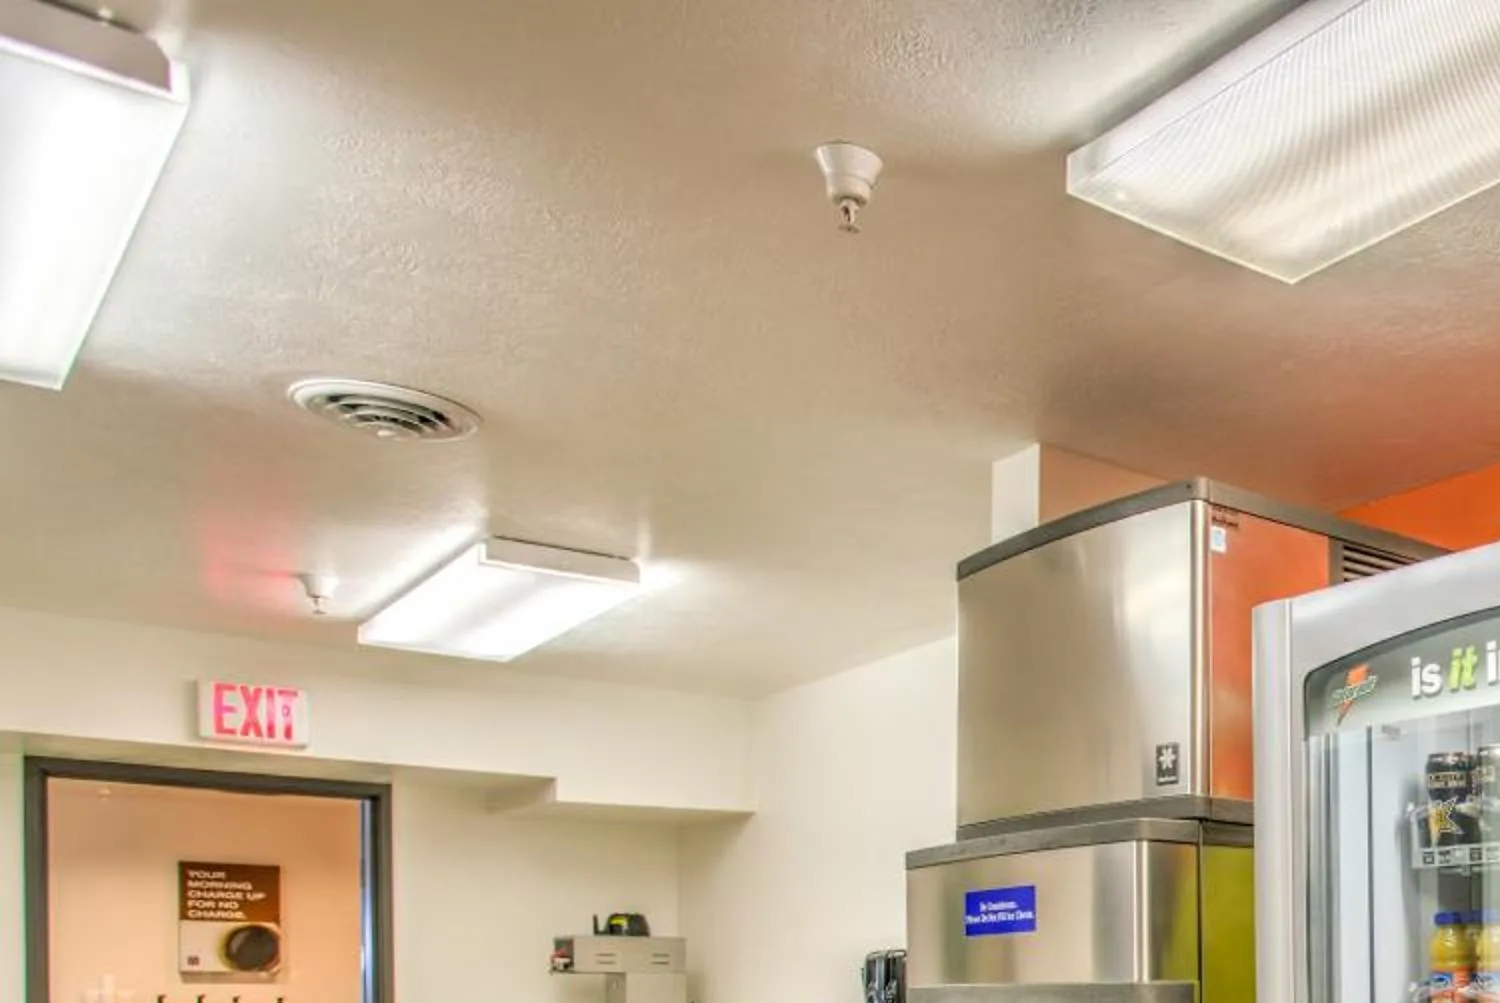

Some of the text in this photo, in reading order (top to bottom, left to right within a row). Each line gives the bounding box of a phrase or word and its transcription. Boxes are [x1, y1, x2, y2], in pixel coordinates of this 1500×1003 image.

[1410, 657, 1442, 698] is
[1449, 645, 1477, 691] it
[213, 682, 299, 742] EXIT
[187, 891, 245, 901] CHARGE
[187, 901, 240, 910] FOR NO
